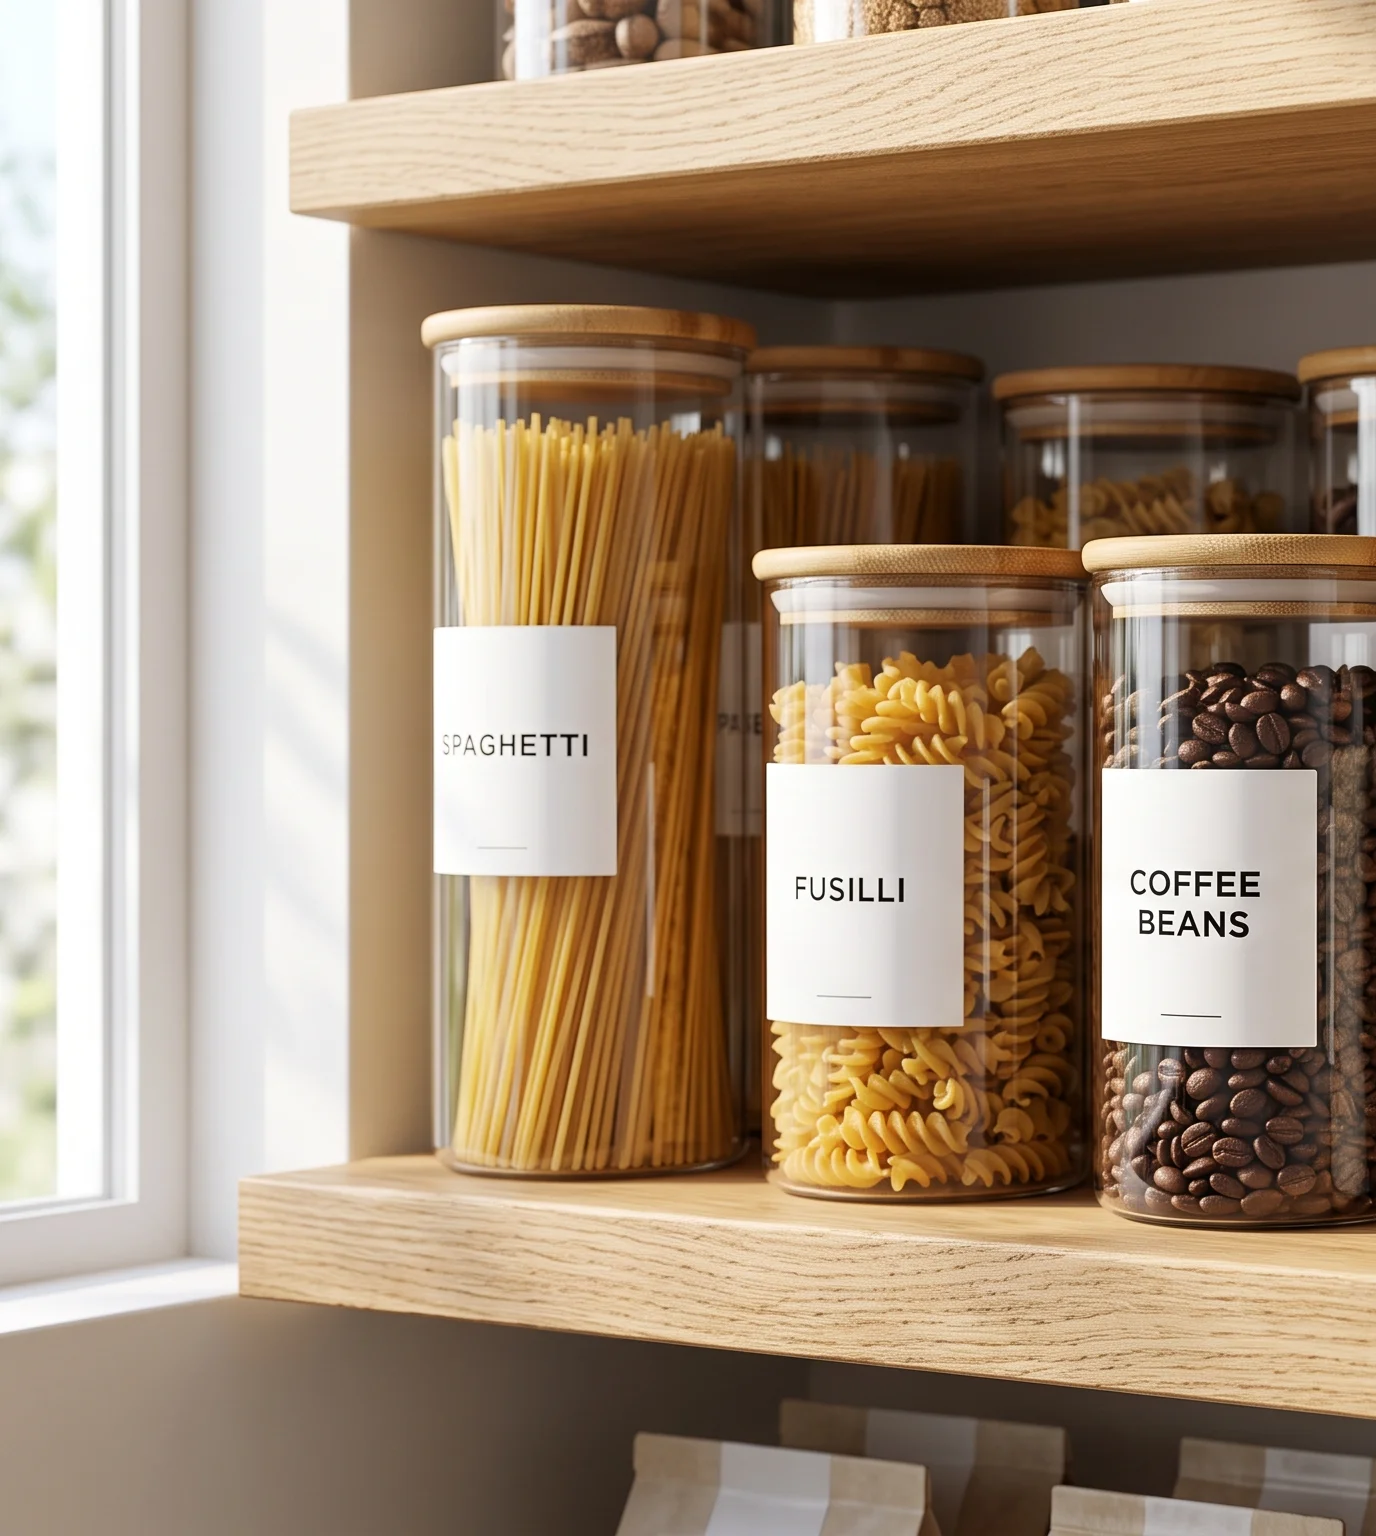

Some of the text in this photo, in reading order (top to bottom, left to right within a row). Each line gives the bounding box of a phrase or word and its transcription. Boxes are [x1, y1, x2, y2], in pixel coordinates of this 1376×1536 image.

[442, 733, 589, 757] SPAGHETTI
[795, 876, 905, 903] FUSILLI
[1130, 869, 1261, 898] COFFEE
[1138, 908, 1250, 939] BEANS
